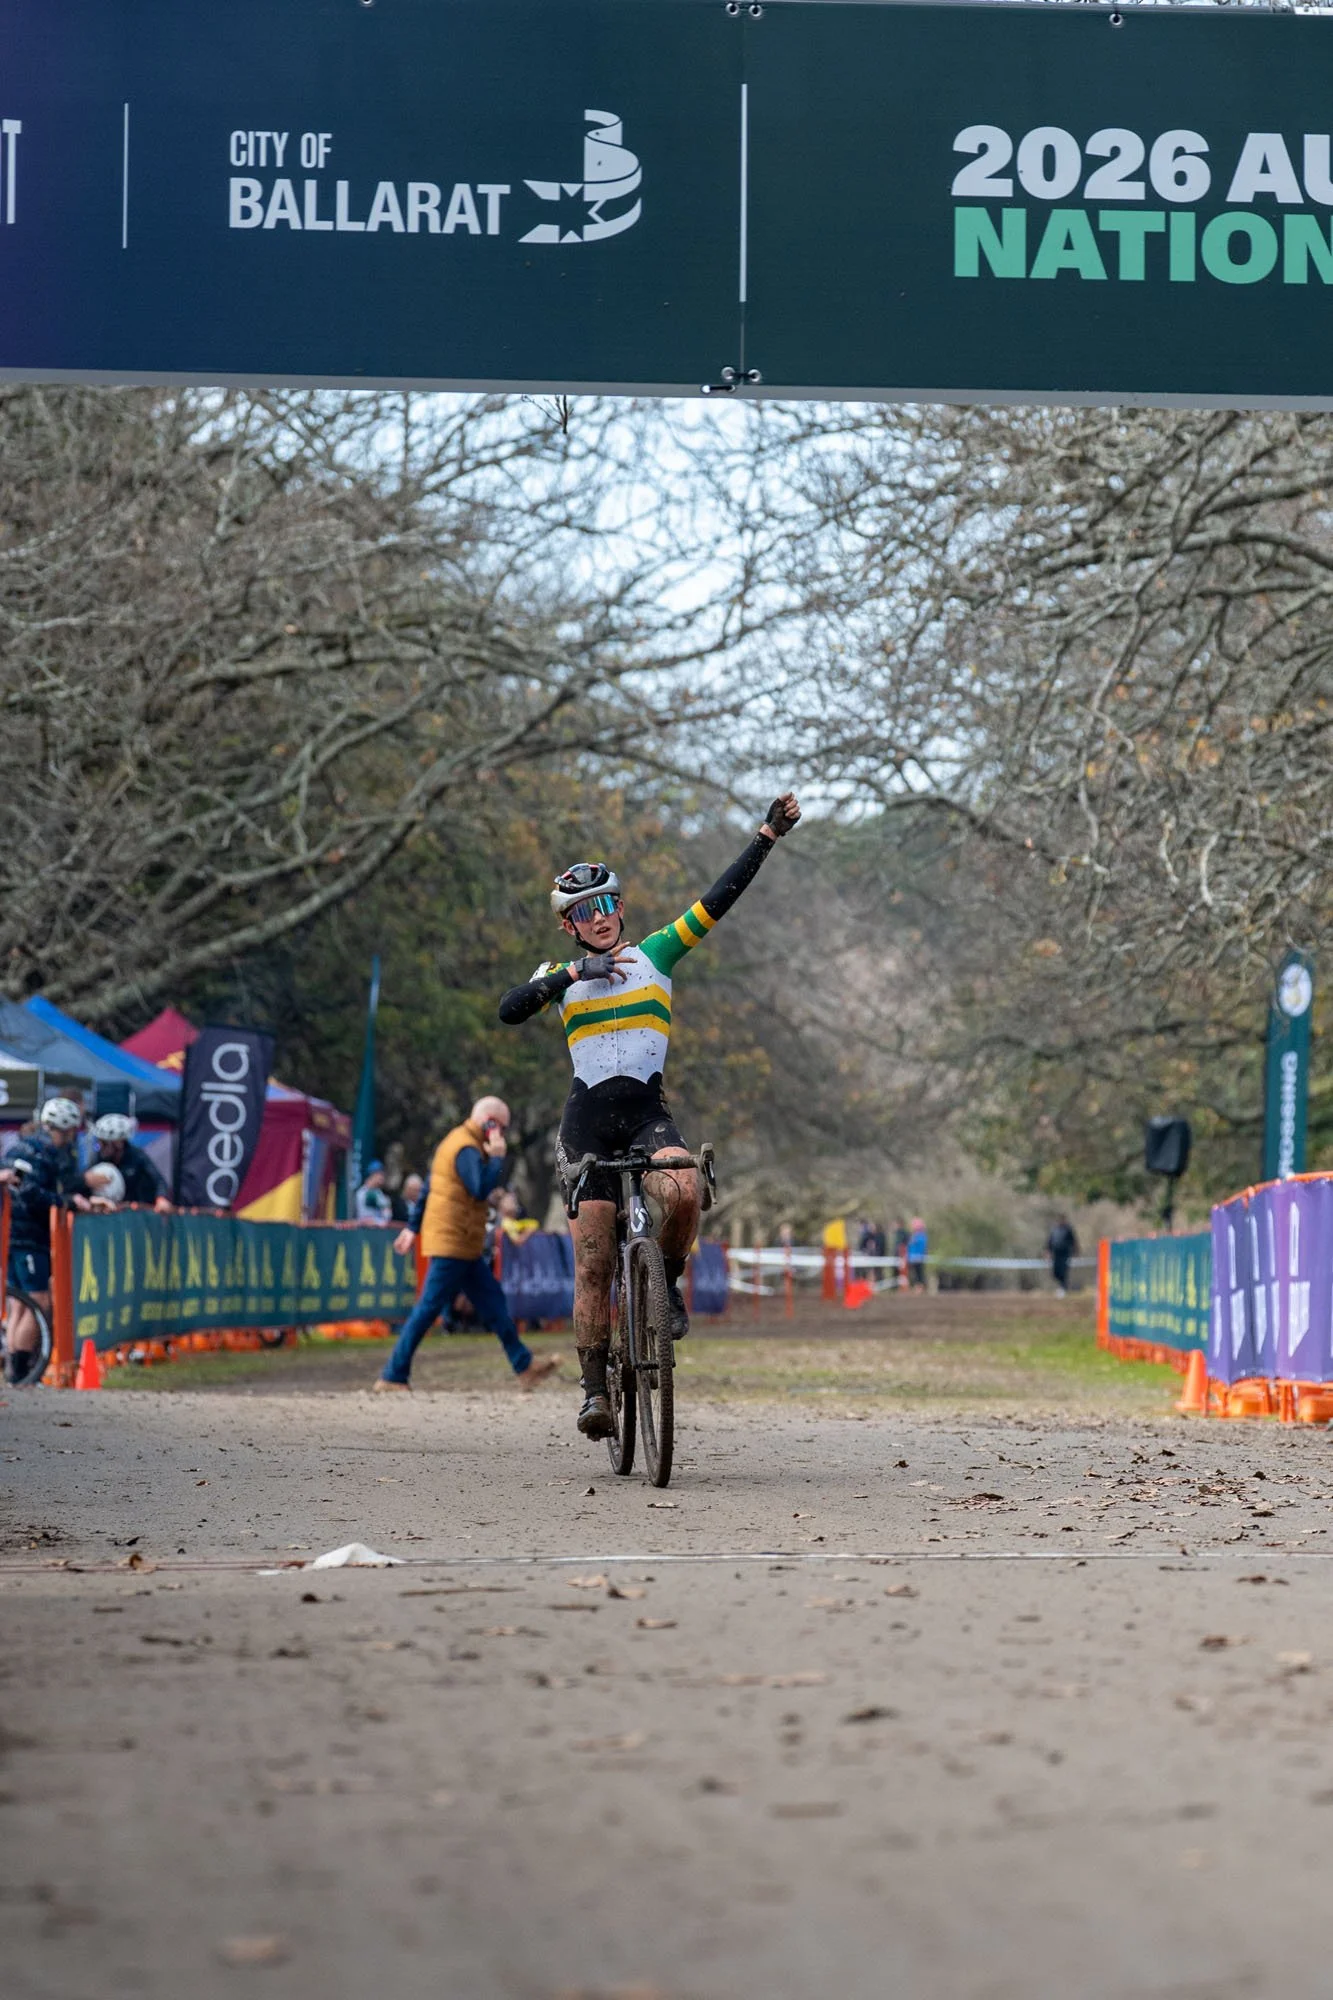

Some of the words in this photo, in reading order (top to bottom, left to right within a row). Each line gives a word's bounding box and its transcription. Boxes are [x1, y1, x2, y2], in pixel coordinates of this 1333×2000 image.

[230, 130, 288, 167] CITY
[301, 132, 332, 168] OF
[951, 125, 1212, 202] 2026
[229, 178, 510, 235] BALLARAT
[954, 206, 1333, 284] NATION
